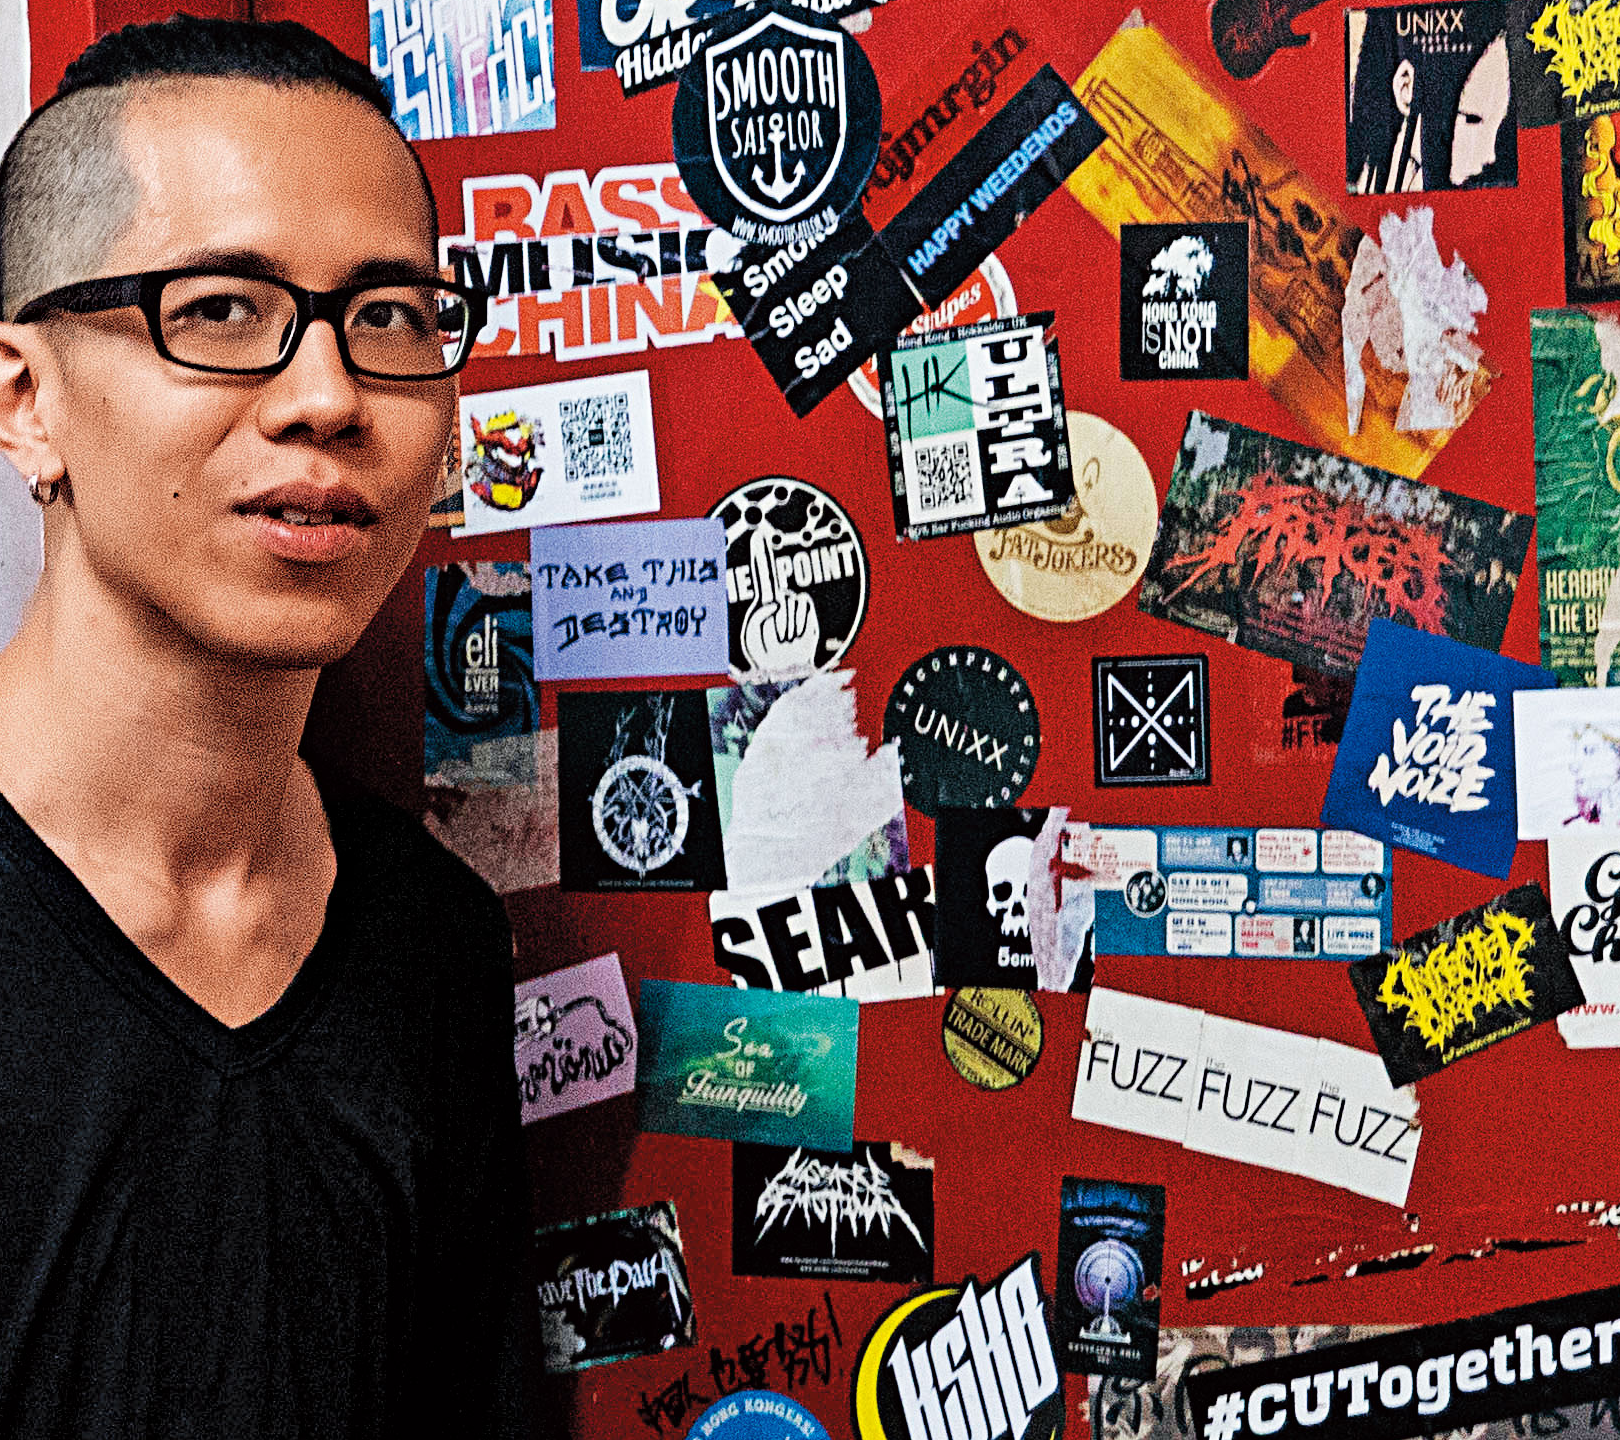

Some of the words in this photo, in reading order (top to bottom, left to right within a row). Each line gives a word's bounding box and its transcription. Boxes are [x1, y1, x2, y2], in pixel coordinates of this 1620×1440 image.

[715, 49, 840, 119] SMOOTH
[905, 206, 974, 278] HAPPY
[968, 100, 1079, 225] WEEDENDS
[768, 263, 850, 341] Sleep
[1140, 305, 1179, 324] HONG
[1180, 301, 1218, 323] KONG
[794, 319, 856, 381] Sad
[1140, 322, 1160, 355] IS
[1161, 321, 1216, 355] NOT
[1158, 351, 1200, 371] CHINA
[537, 563, 629, 590] TAKE
[641, 557, 720, 588] THIS
[609, 584, 650, 604] AND
[554, 607, 710, 653] DESTROY
[1409, 683, 1495, 734] THE
[911, 703, 1011, 774] UNiXX
[1391, 718, 1489, 769] VOID
[1367, 755, 1492, 815] NOIZE
[713, 865, 935, 992] SEAR
[721, 1017, 773, 1062] Sea
[679, 1071, 810, 1121] Tranquility
[1085, 1037, 1190, 1106] FUZZ
[1196, 1069, 1302, 1136] FUZZ
[1309, 1088, 1416, 1166] FUZZ
